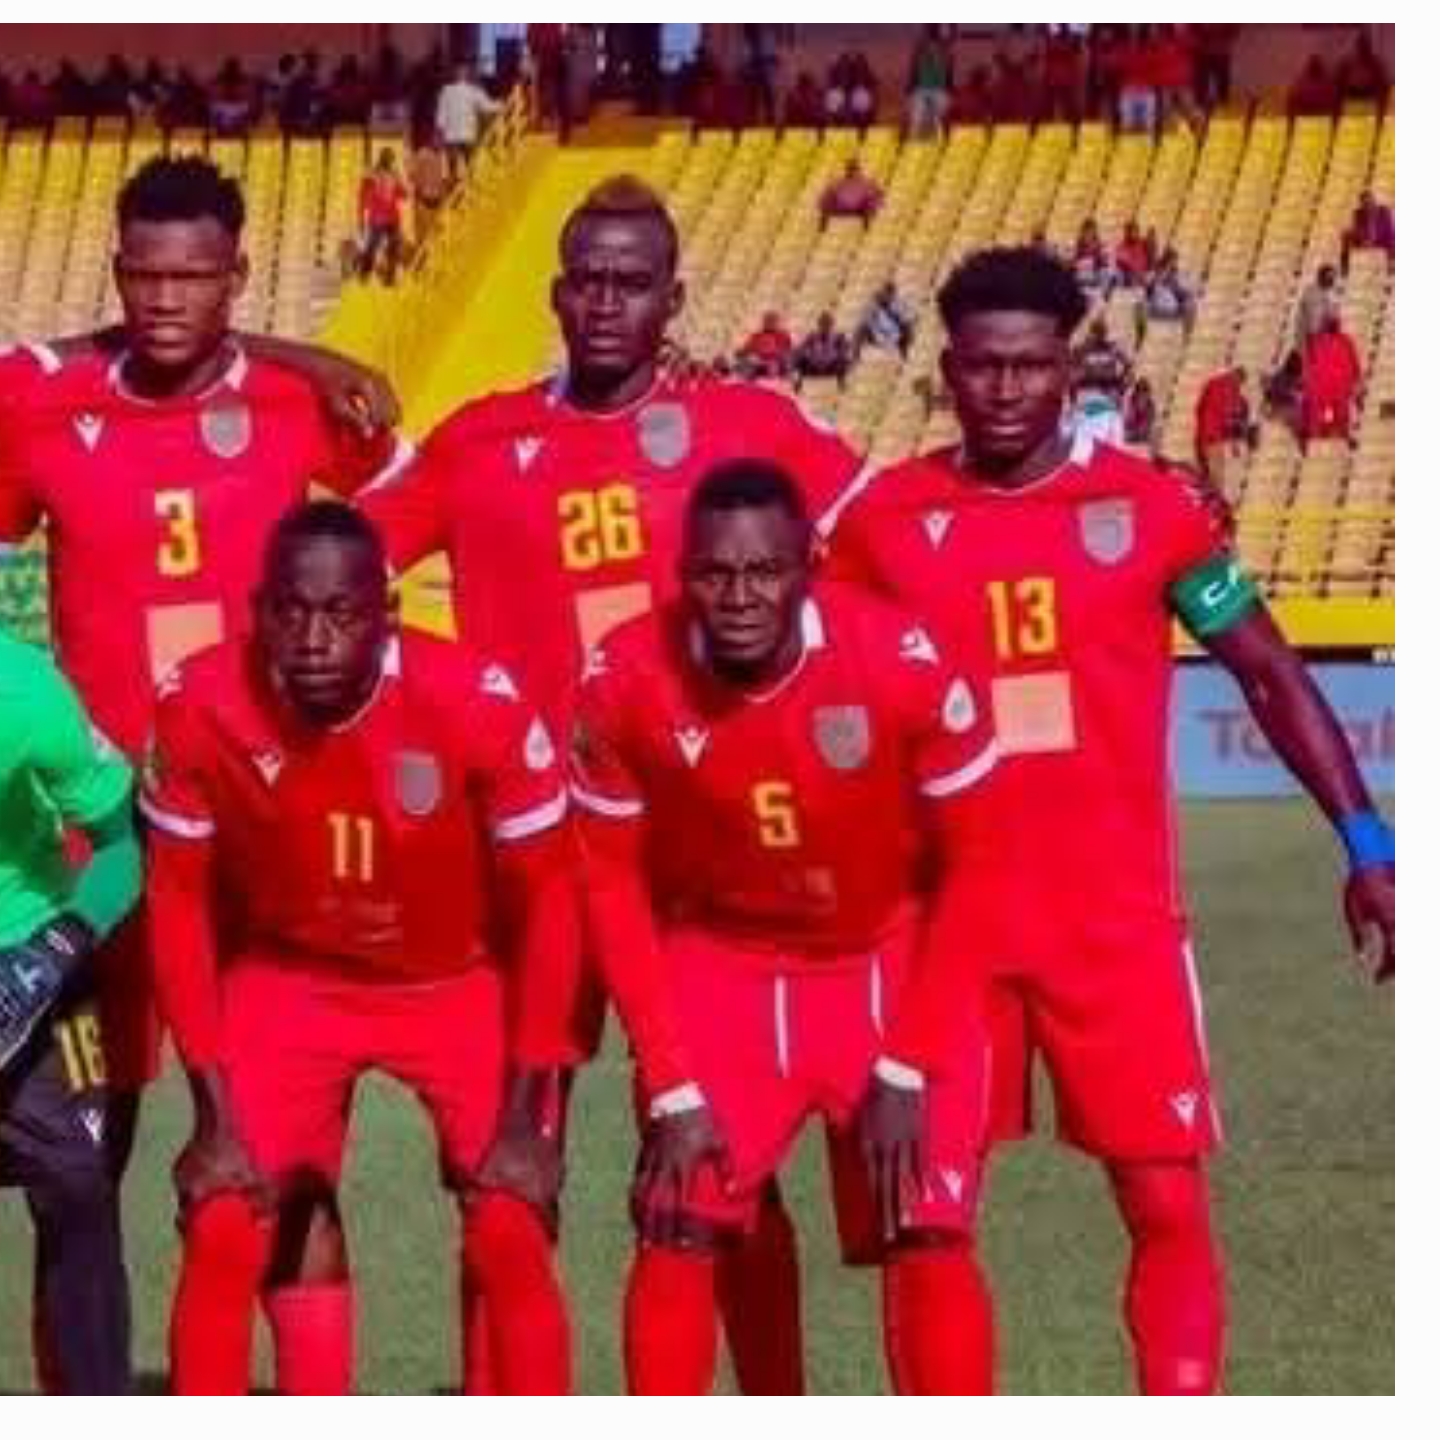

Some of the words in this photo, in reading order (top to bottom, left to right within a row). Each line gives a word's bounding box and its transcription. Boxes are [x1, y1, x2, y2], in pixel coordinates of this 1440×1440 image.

[154, 488, 200, 575] 3
[558, 483, 643, 569] 26
[985, 578, 1056, 658] 13
[326, 812, 373, 882] 11
[753, 781, 800, 848] 5
